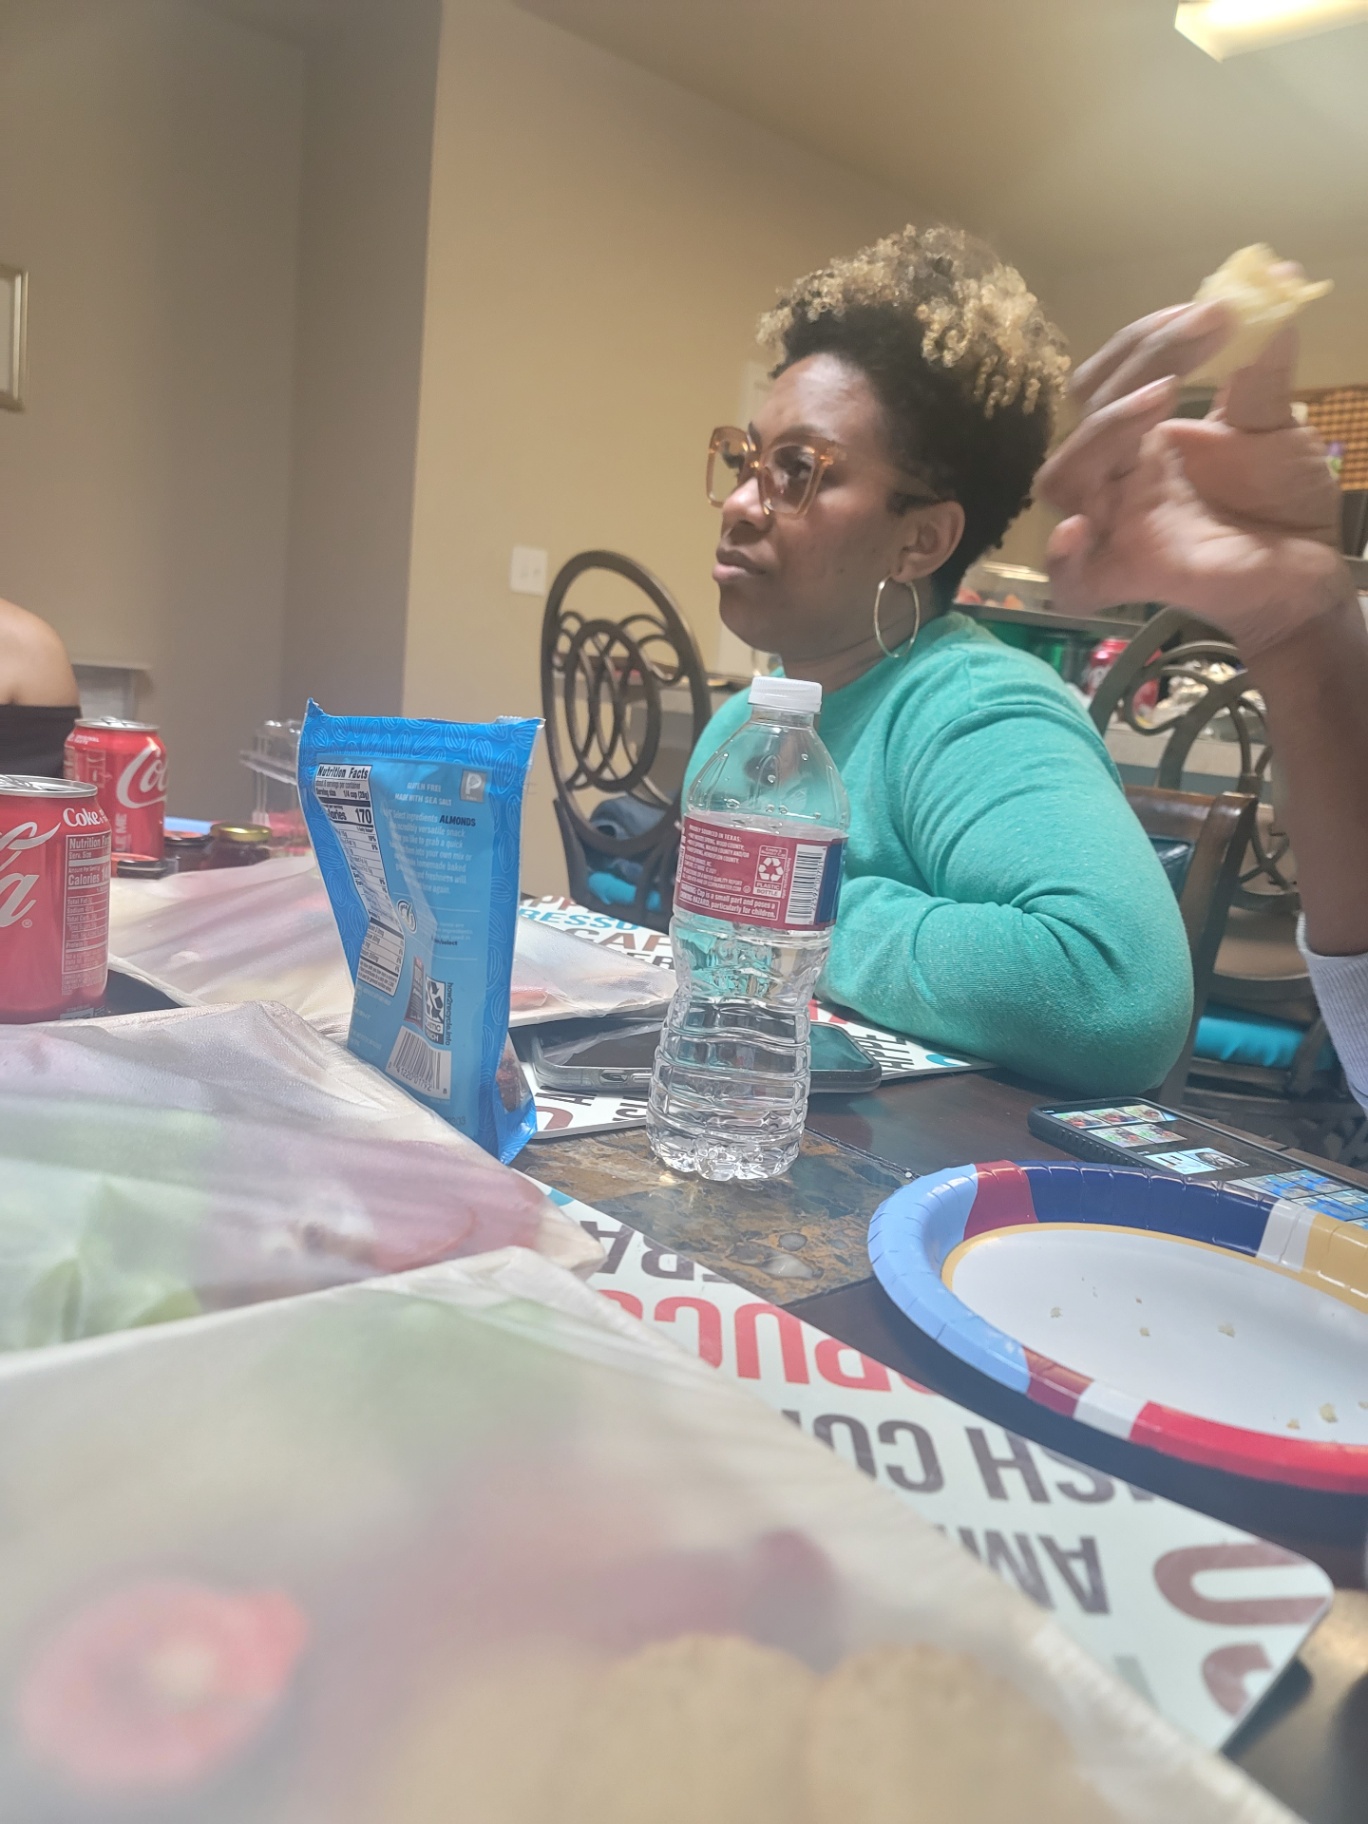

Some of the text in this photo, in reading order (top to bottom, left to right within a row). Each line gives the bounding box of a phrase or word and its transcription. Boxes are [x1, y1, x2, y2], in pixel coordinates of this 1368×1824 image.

[317, 765, 369, 780] Nutrition Facts
[424, 796, 438, 804] SEA
[63, 807, 98, 827] Coke
[355, 808, 373, 824] 170
[439, 814, 477, 827] ALMONDS
[69, 836, 101, 850] Nutrition
[425, 836, 440, 847] grab
[724, 833, 742, 843] TEXAS:
[68, 872, 100, 886] Calories
[756, 882, 780, 890] PLASTIC
[697, 888, 706, 898] Cap
[714, 894, 730, 902] small
[730, 896, 743, 904] part
[753, 901, 771, 909] poses
[756, 888, 778, 896] BOTTLE
[710, 901, 742, 915] particularly
[742, 906, 751, 914] for
[751, 907, 776, 918] children.
[445, 981, 455, 1046] how2recycle.info
[780, 1408, 1155, 1504] SH CO
[935, 1523, 1112, 1616] AM
